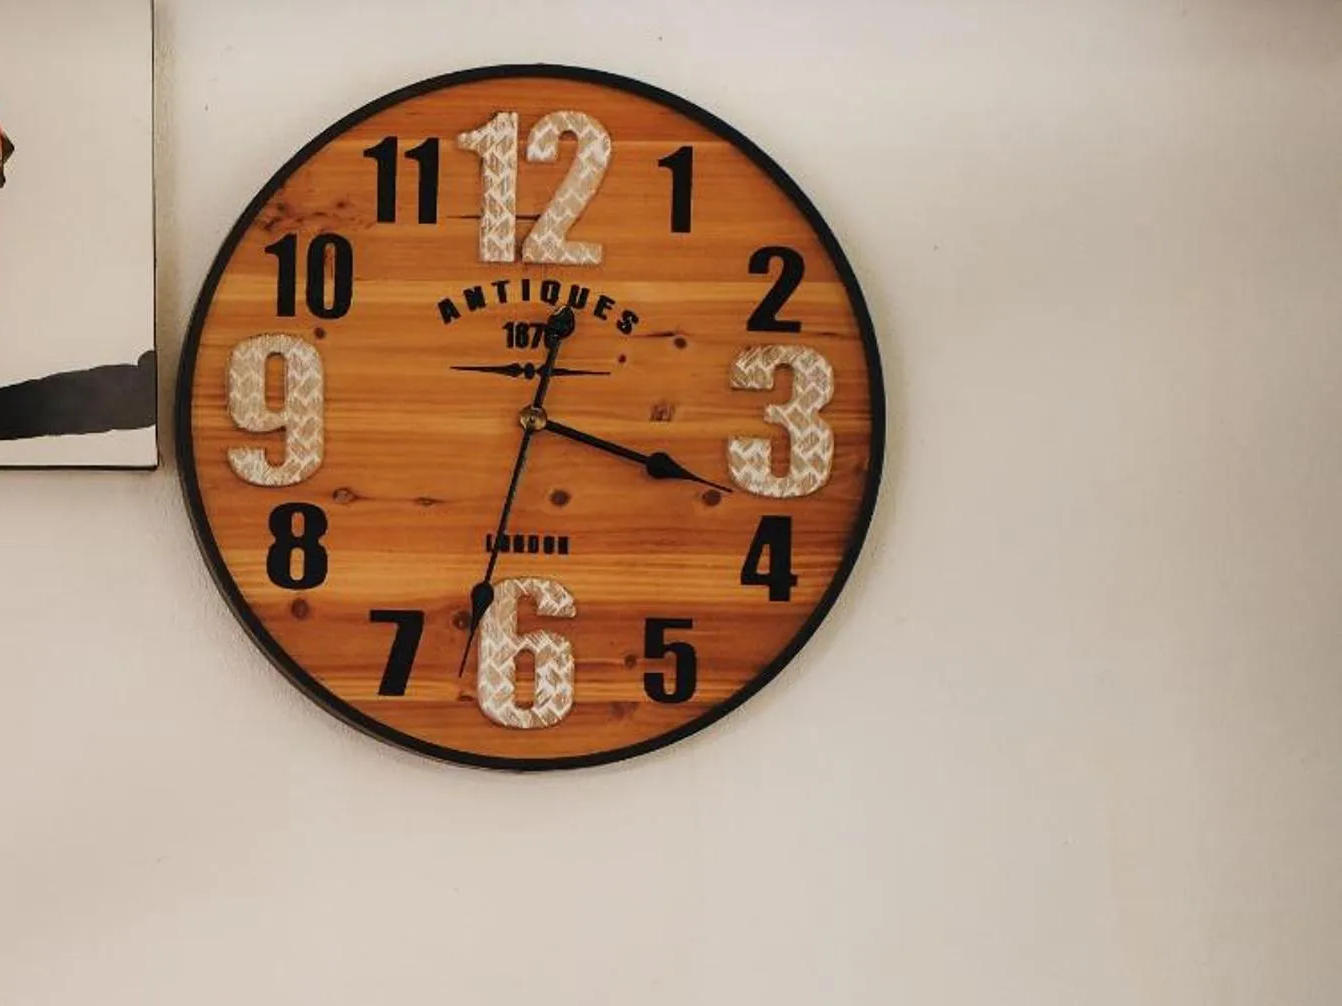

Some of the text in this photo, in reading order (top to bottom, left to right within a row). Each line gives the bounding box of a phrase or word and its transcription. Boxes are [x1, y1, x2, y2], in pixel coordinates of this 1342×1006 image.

[363, 136, 440, 224] 11
[459, 111, 611, 264] 12
[658, 146, 693, 233] 1
[264, 233, 353, 320] 10
[438, 279, 639, 335] ANTIQUES
[747, 247, 805, 332] 2
[227, 335, 324, 487] 9
[728, 346, 835, 498] 3
[266, 503, 329, 590] 8
[486, 534, 569, 555] LONDON
[741, 516, 797, 602] 4
[369, 610, 425, 697] 7
[477, 577, 576, 730] 6
[644, 618, 696, 703] 5
